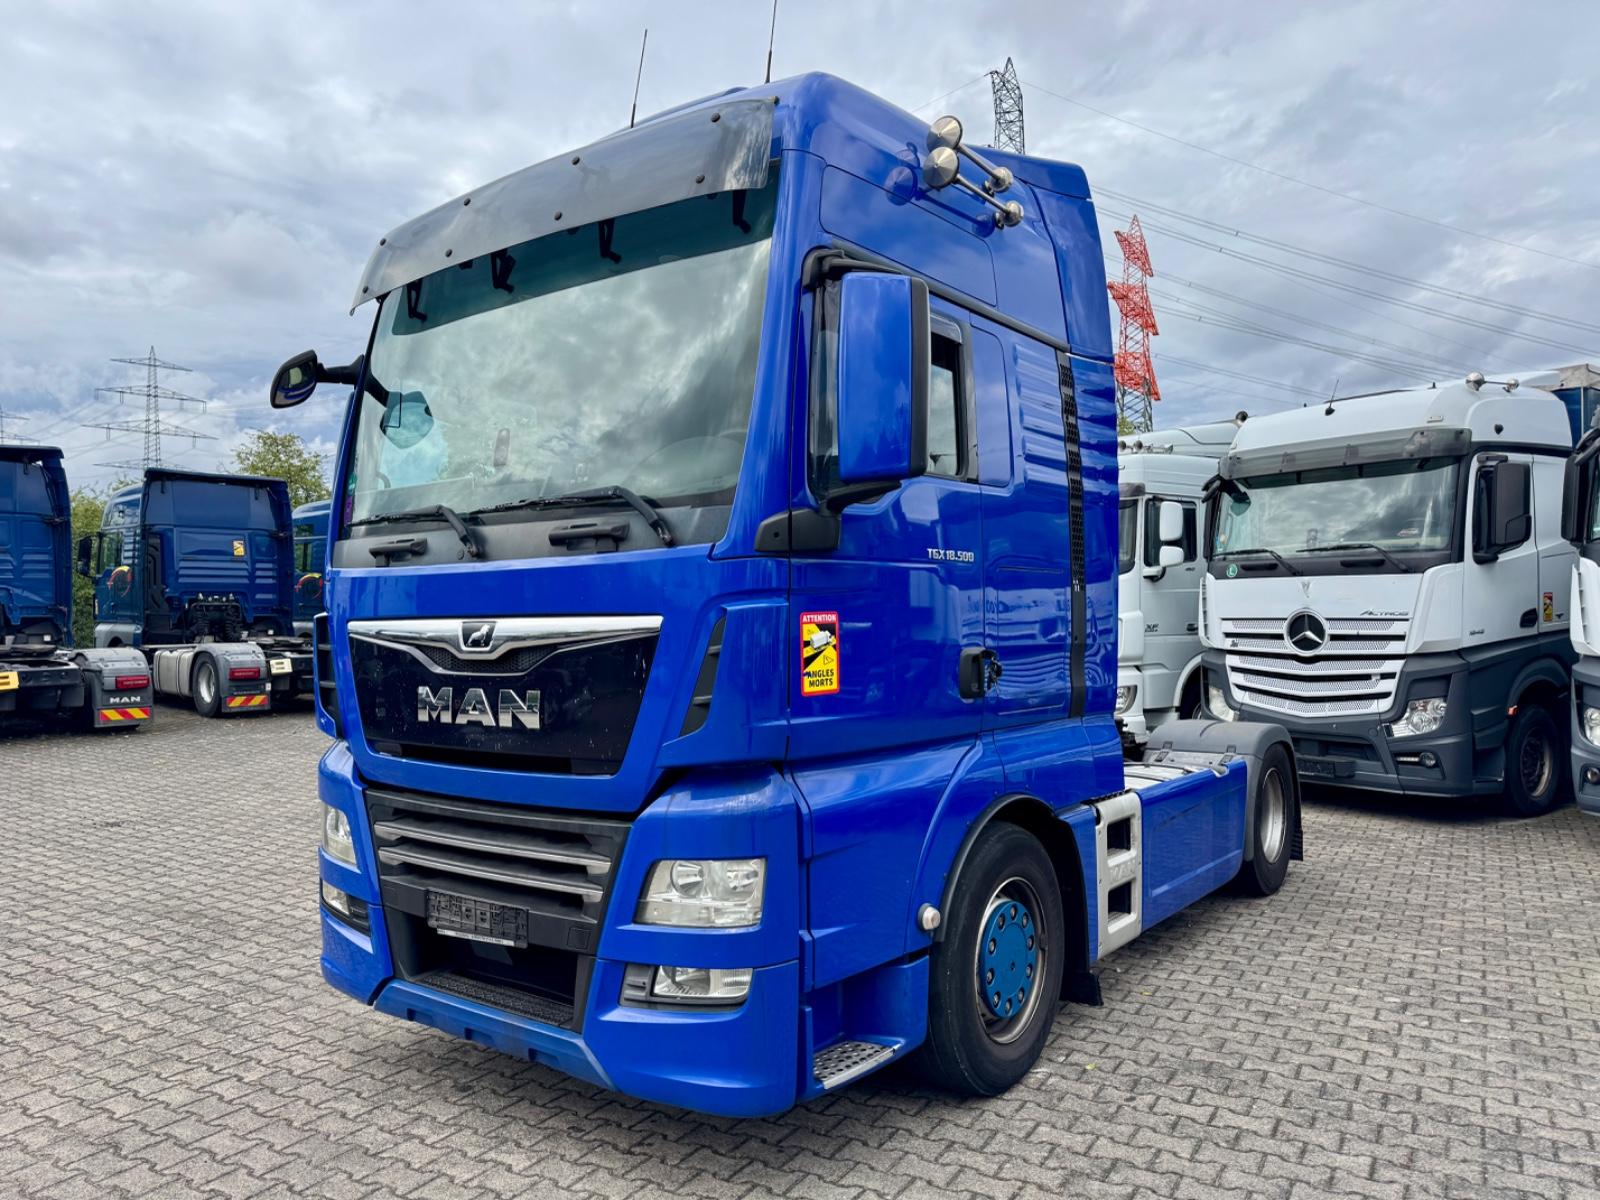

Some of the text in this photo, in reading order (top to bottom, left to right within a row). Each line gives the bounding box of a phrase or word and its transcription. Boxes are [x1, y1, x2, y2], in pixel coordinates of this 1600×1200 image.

[927, 548, 975, 562] TGX 18.500
[802, 614, 837, 622] ATTENTION
[808, 669, 835, 679] ANGLES
[809, 678, 833, 688] MORTS
[110, 696, 141, 704] MAN
[417, 686, 540, 729] MAN
